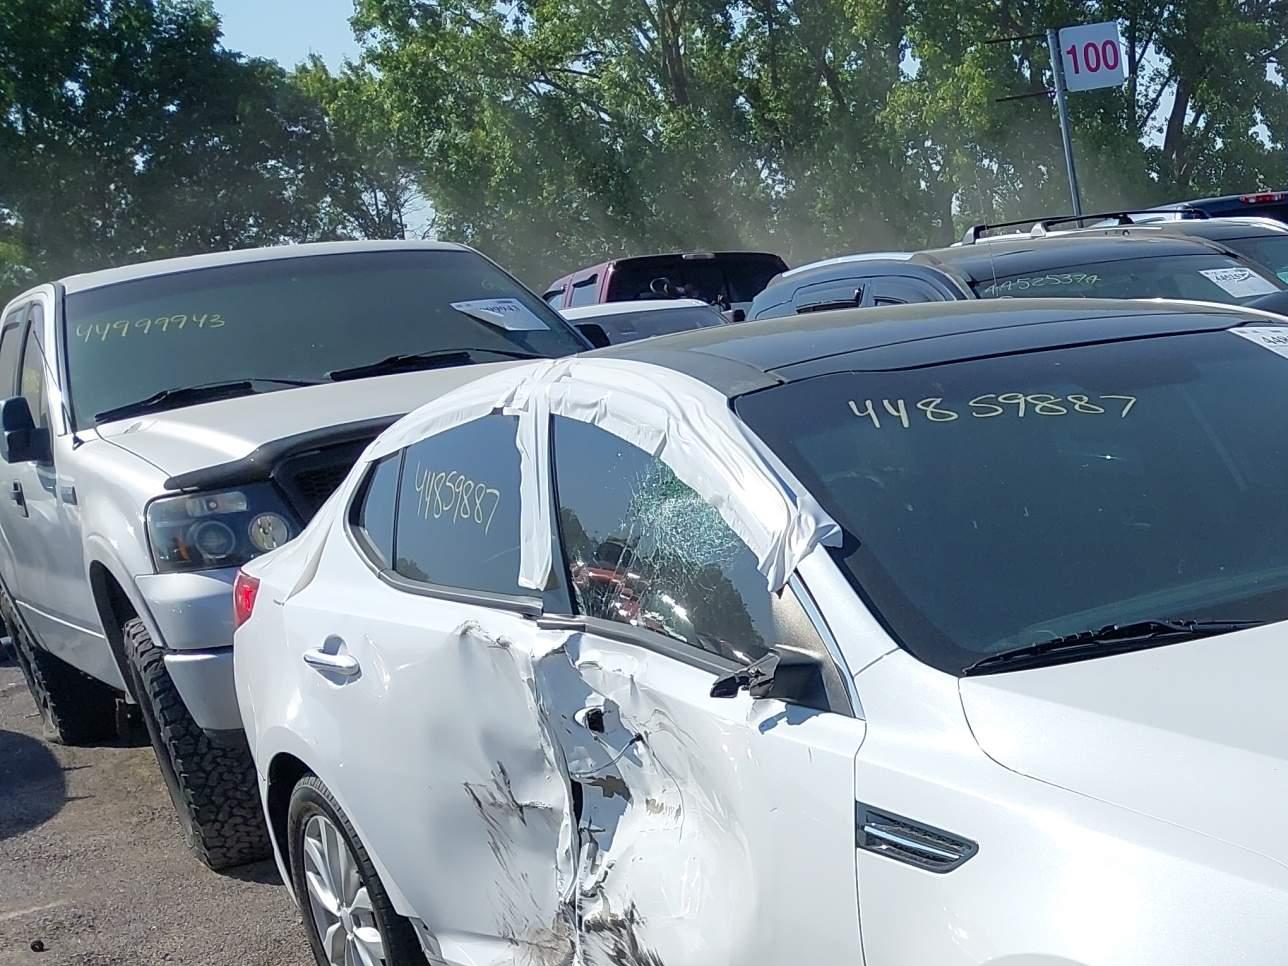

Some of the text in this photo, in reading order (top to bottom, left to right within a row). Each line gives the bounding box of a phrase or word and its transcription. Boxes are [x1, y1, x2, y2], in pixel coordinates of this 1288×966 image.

[1066, 40, 1119, 74] 100
[848, 393, 1136, 428] 44859887
[415, 461, 500, 536] 44859887
